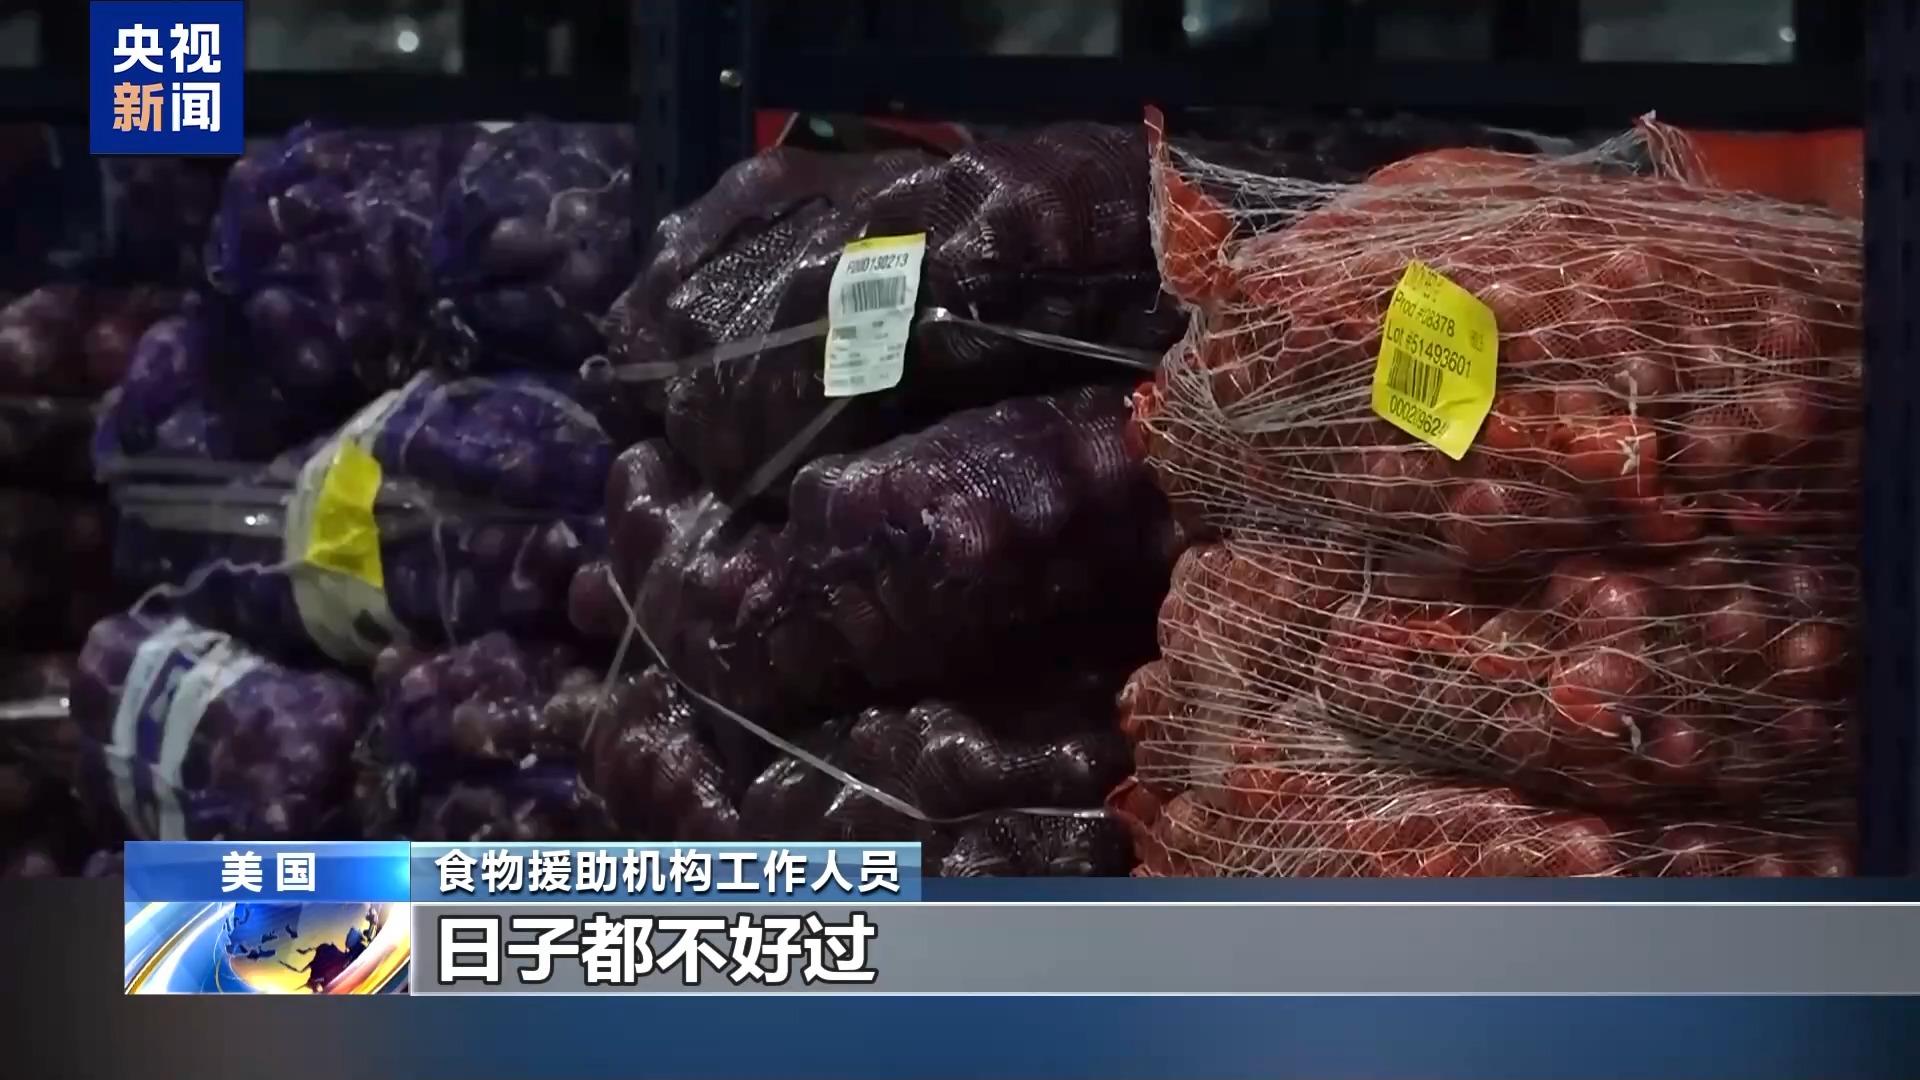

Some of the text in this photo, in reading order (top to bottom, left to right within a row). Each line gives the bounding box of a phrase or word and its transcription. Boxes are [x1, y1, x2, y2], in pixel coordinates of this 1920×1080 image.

[1393, 289, 1416, 318] Prod
[1387, 319, 1405, 347] Lot
[1405, 331, 1472, 379] #51493601
